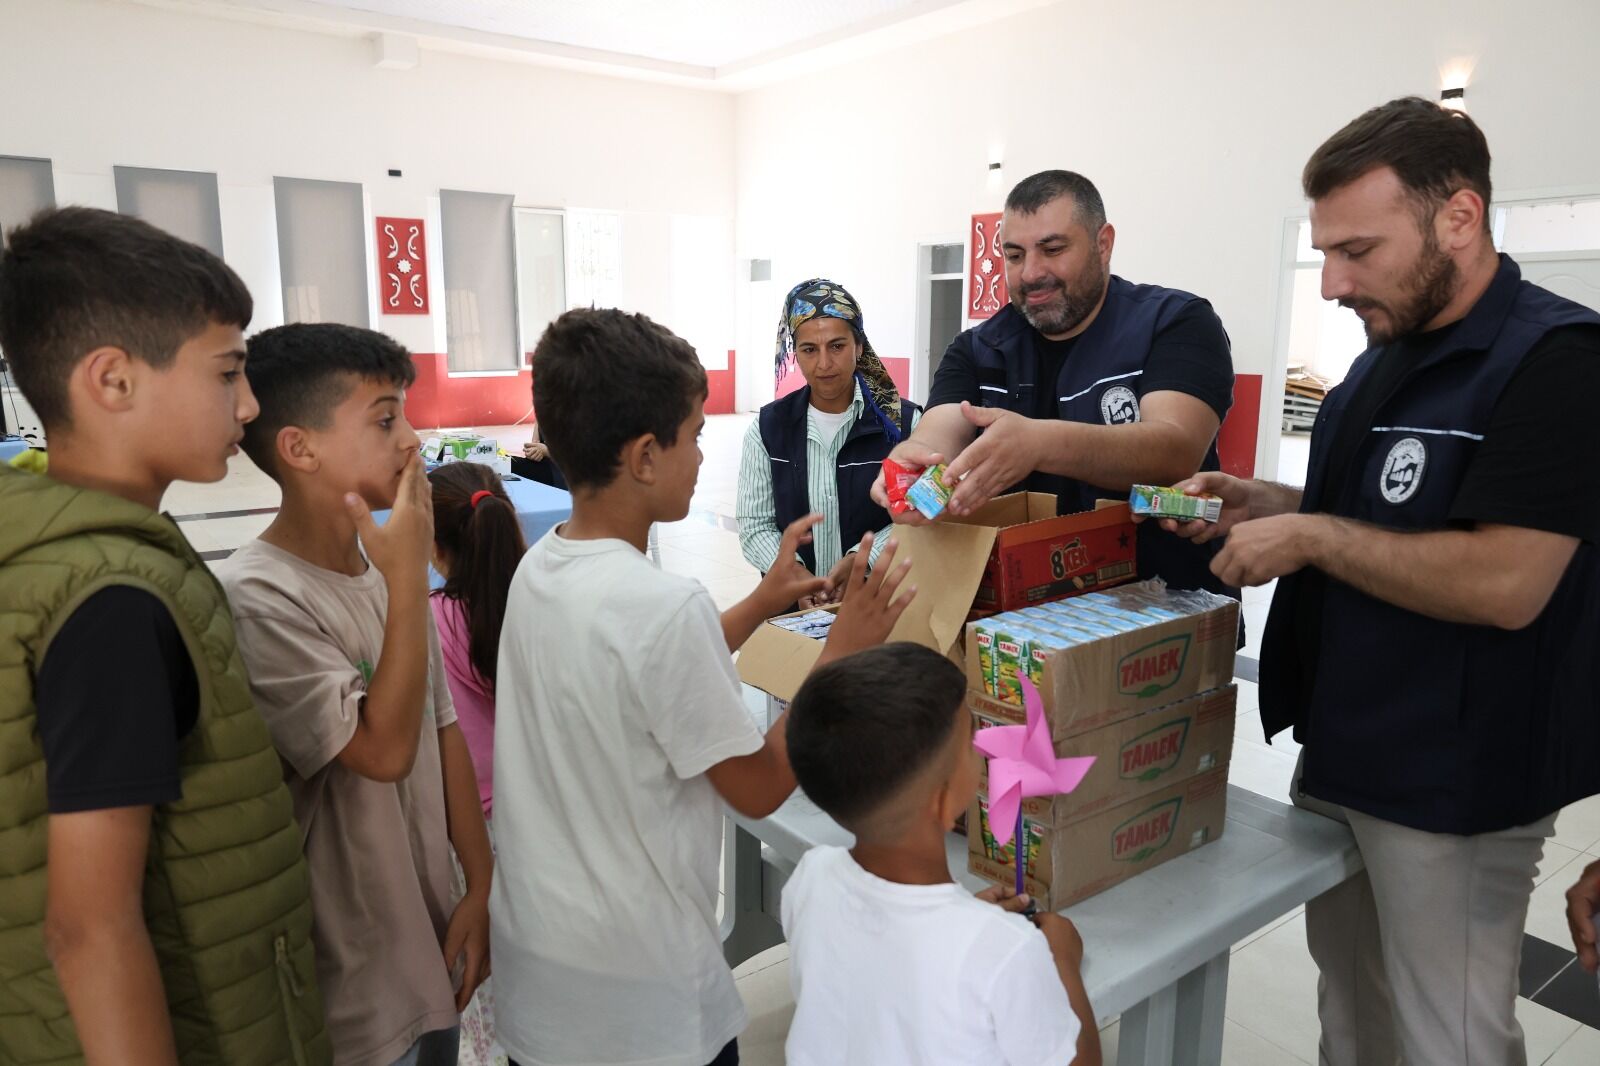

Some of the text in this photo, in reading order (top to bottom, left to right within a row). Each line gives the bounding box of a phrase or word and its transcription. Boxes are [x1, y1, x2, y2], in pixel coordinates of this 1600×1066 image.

[999, 642, 1019, 653] TAMEK
[1120, 648, 1180, 688] TAMEK
[1122, 730, 1180, 772] TAMEK
[1115, 810, 1172, 856] TAMEK
